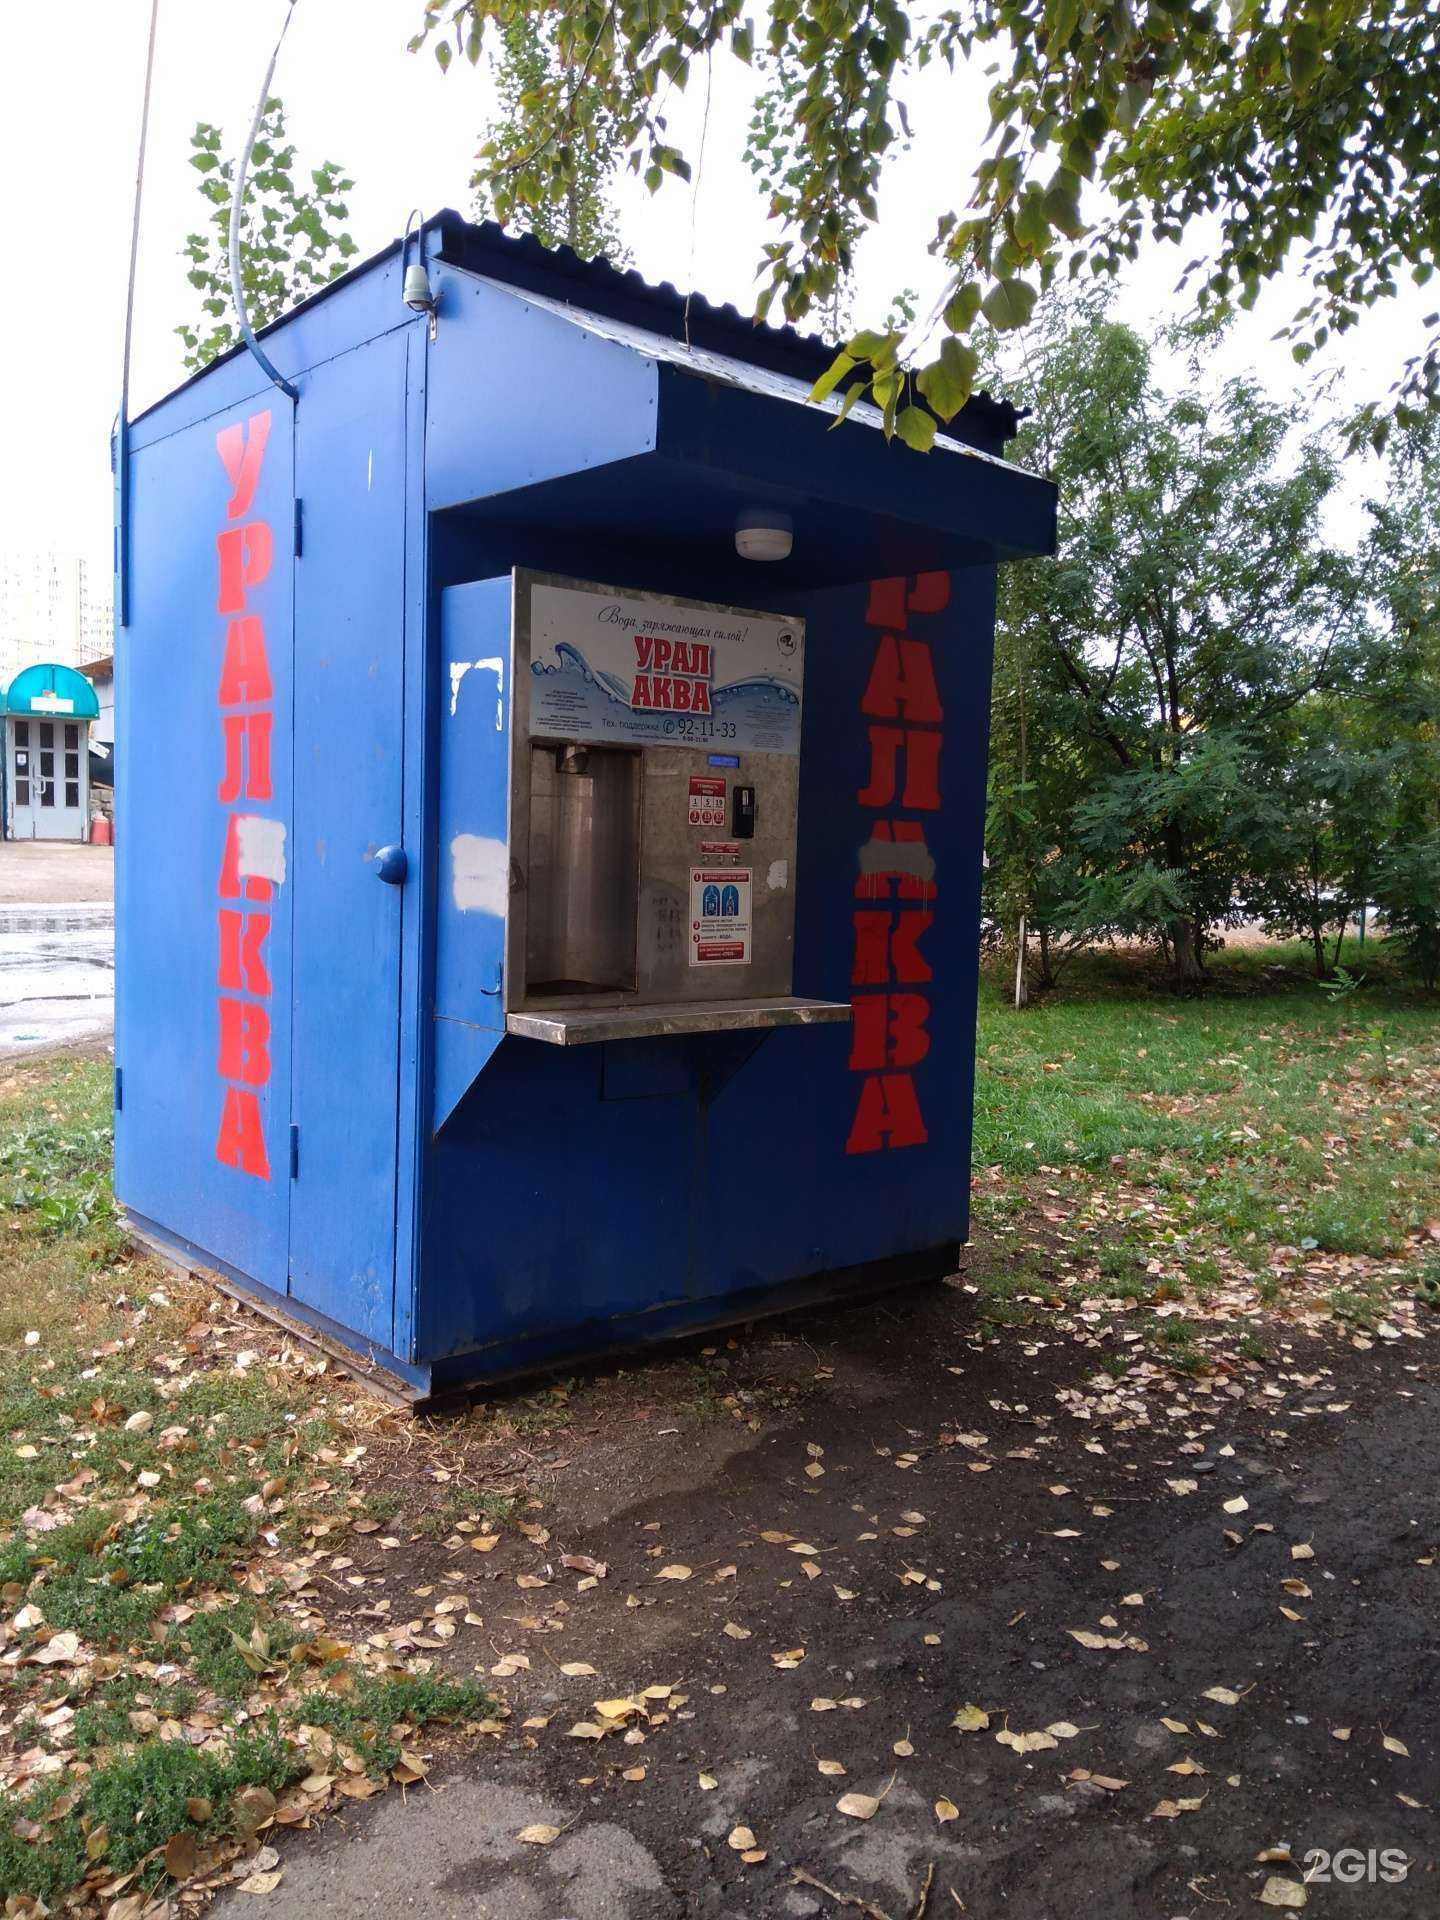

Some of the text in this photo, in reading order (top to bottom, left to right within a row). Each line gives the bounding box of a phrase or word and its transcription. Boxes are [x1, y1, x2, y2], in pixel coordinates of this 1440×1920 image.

[639, 619, 711, 637] заряжающая
[633, 635, 711, 675] УРАЛ
[631, 674, 712, 713] АКВА
[677, 718, 737, 738] 92-11-33
